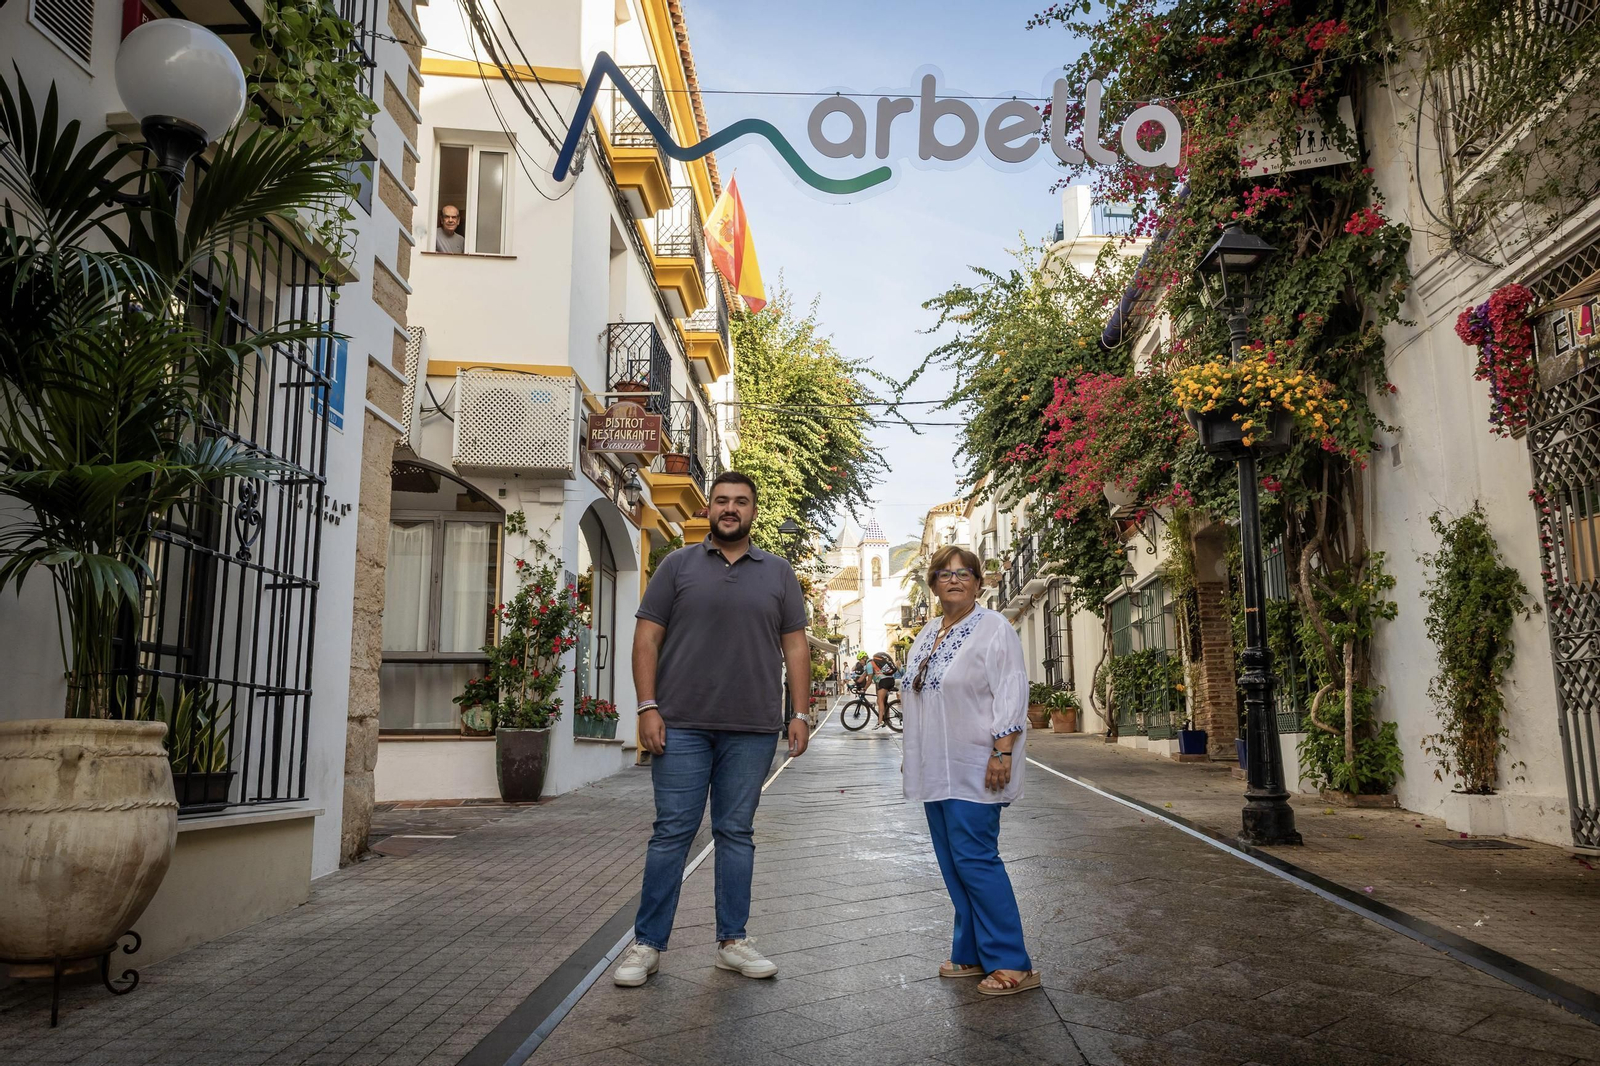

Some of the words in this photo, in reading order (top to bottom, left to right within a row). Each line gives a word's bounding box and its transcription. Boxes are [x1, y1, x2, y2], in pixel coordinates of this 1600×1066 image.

[605, 417, 644, 428] BISTROT
[591, 429, 656, 440] RESTAURANTE
[600, 438, 646, 451] Casanis
